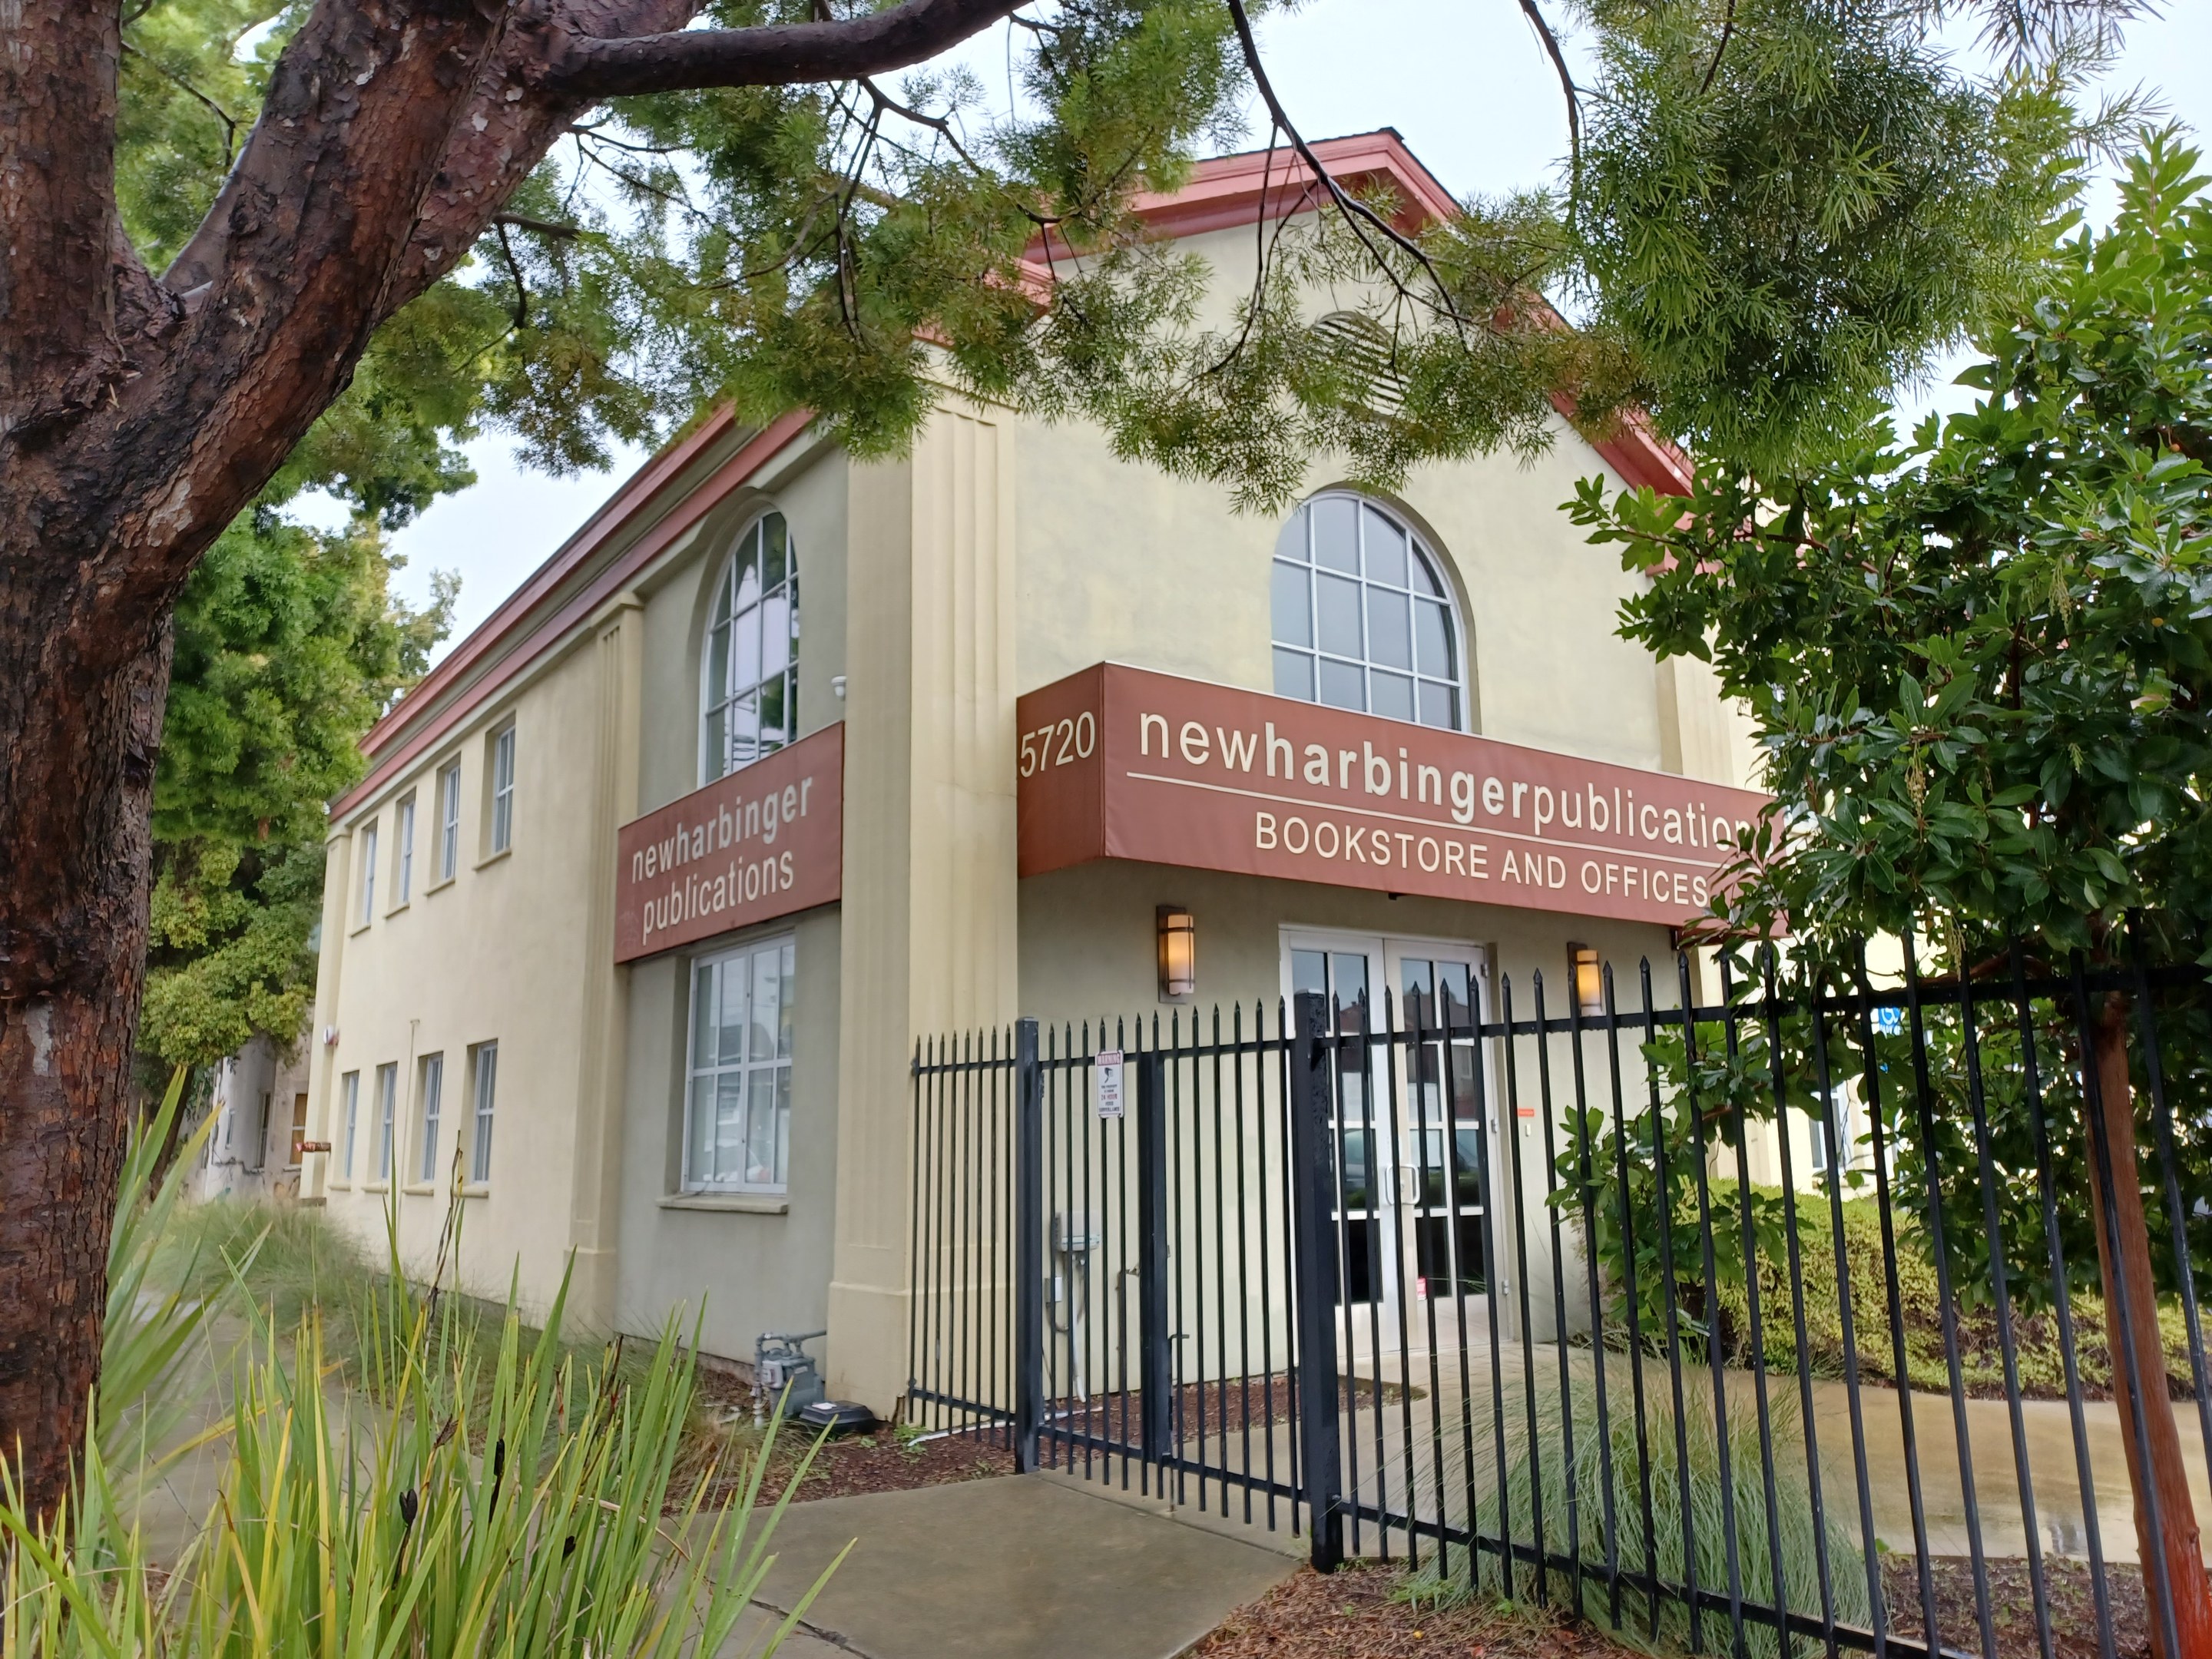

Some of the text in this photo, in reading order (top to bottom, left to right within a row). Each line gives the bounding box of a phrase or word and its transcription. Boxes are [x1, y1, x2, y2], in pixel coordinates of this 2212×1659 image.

[1020, 711, 1095, 777] 5720
[632, 777, 813, 883] newharbinger
[1257, 811, 1709, 907] BOOKSTORE AND OFFICES
[642, 850, 794, 945] publications
[1098, 1054, 1120, 1065] WARNING
